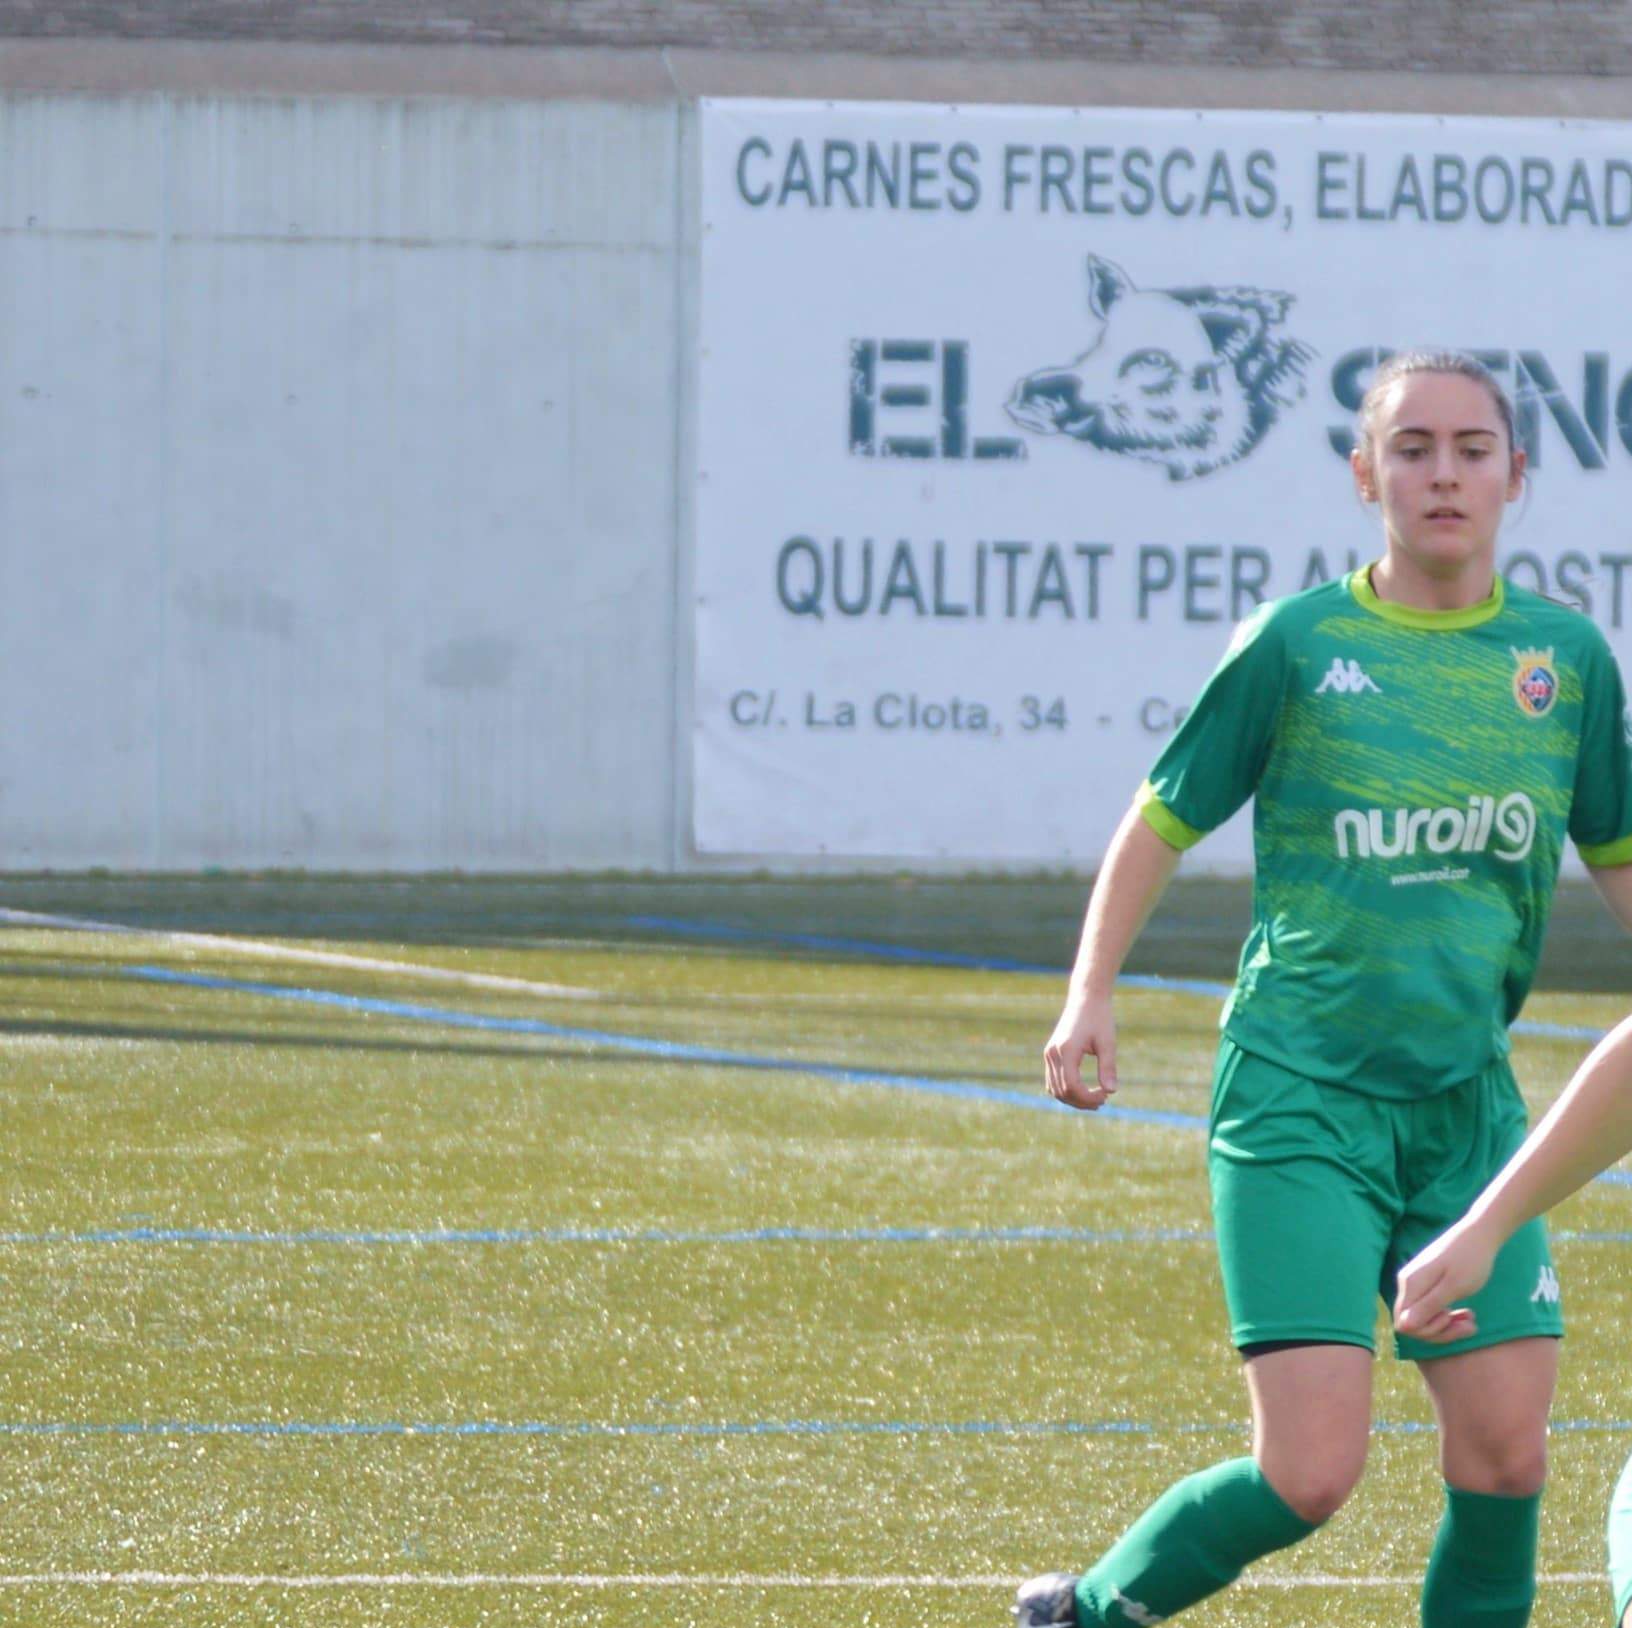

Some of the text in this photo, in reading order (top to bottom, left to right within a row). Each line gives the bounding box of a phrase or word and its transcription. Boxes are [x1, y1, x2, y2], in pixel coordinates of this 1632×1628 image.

[734, 135, 982, 214] CARNES
[1002, 143, 1294, 231] FRESCAS,
[848, 340, 1027, 461] EL
[774, 534, 1115, 622] QUALITAT
[1136, 543, 1273, 624] PER
[803, 691, 857, 730] La
[871, 692, 1003, 738] Clota,
[1019, 695, 1070, 733] 34
[1334, 794, 1495, 859] nuroil
